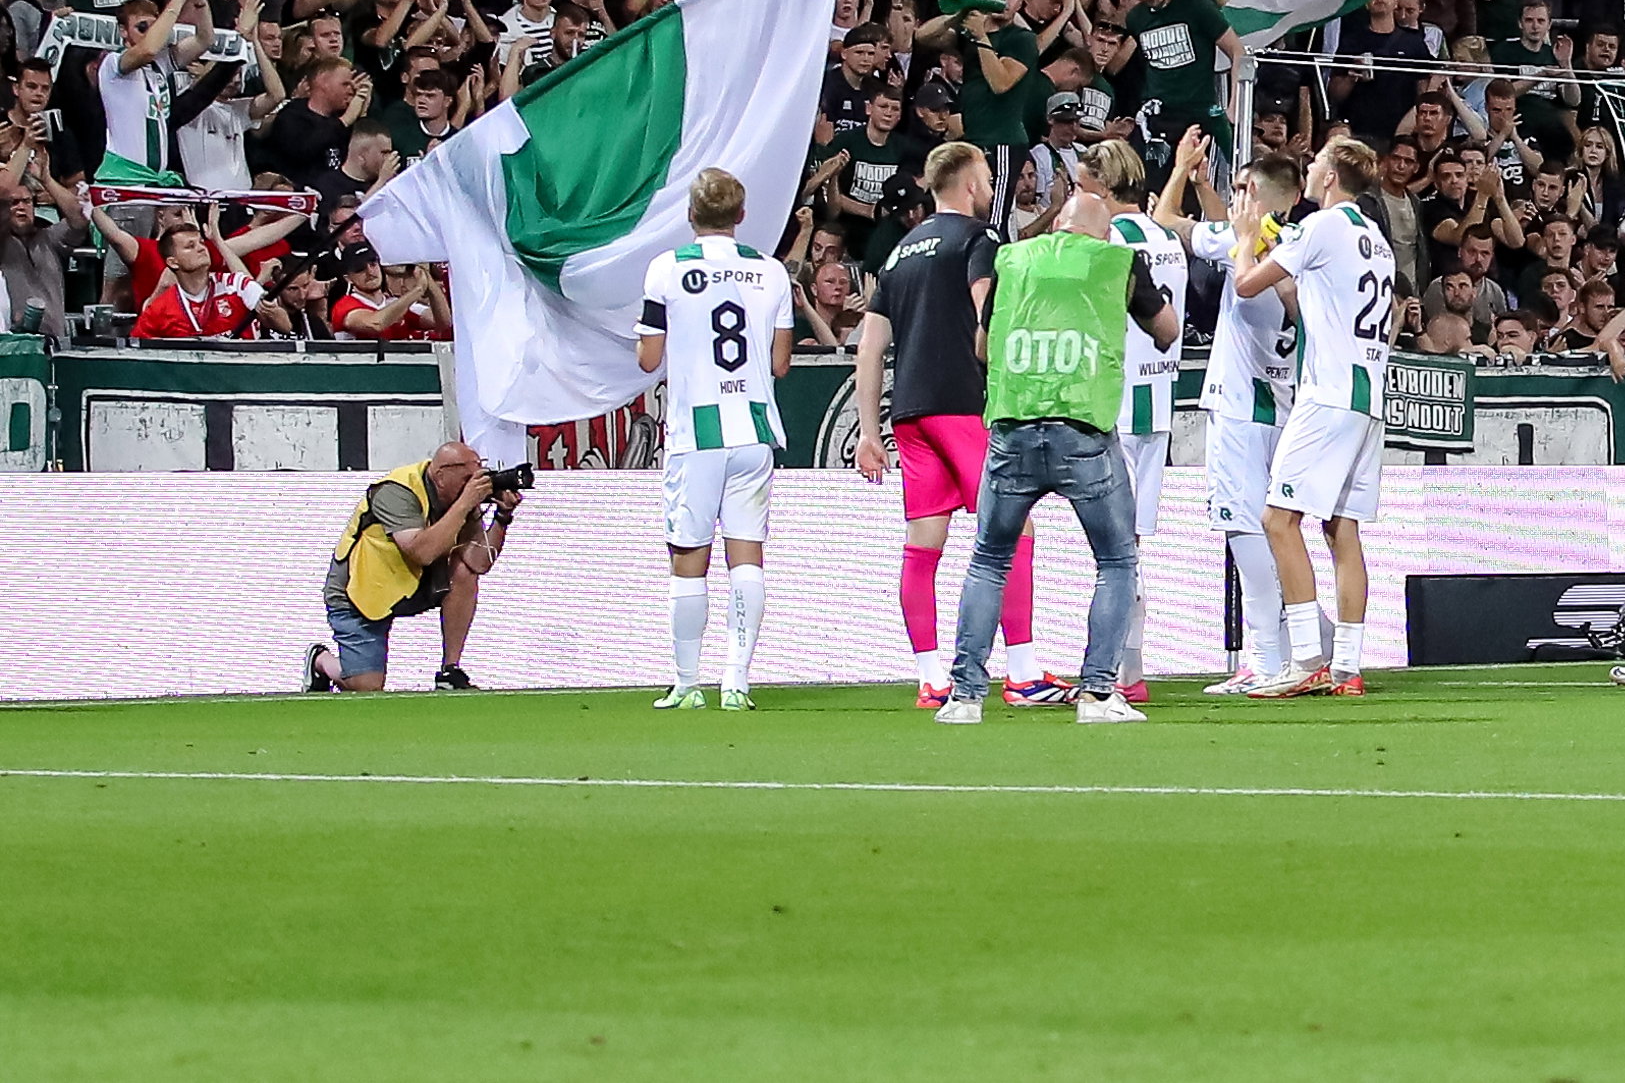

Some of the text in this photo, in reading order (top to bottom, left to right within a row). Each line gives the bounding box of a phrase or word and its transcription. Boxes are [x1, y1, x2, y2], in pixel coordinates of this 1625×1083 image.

[900, 237, 941, 259] SPORT
[712, 271, 764, 285] SPORT
[1355, 270, 1394, 345] 22
[711, 300, 747, 372] 8
[720, 379, 746, 394] HOVE
[1386, 366, 1464, 398] ERBODEN
[1408, 402, 1463, 433] NOOIT
